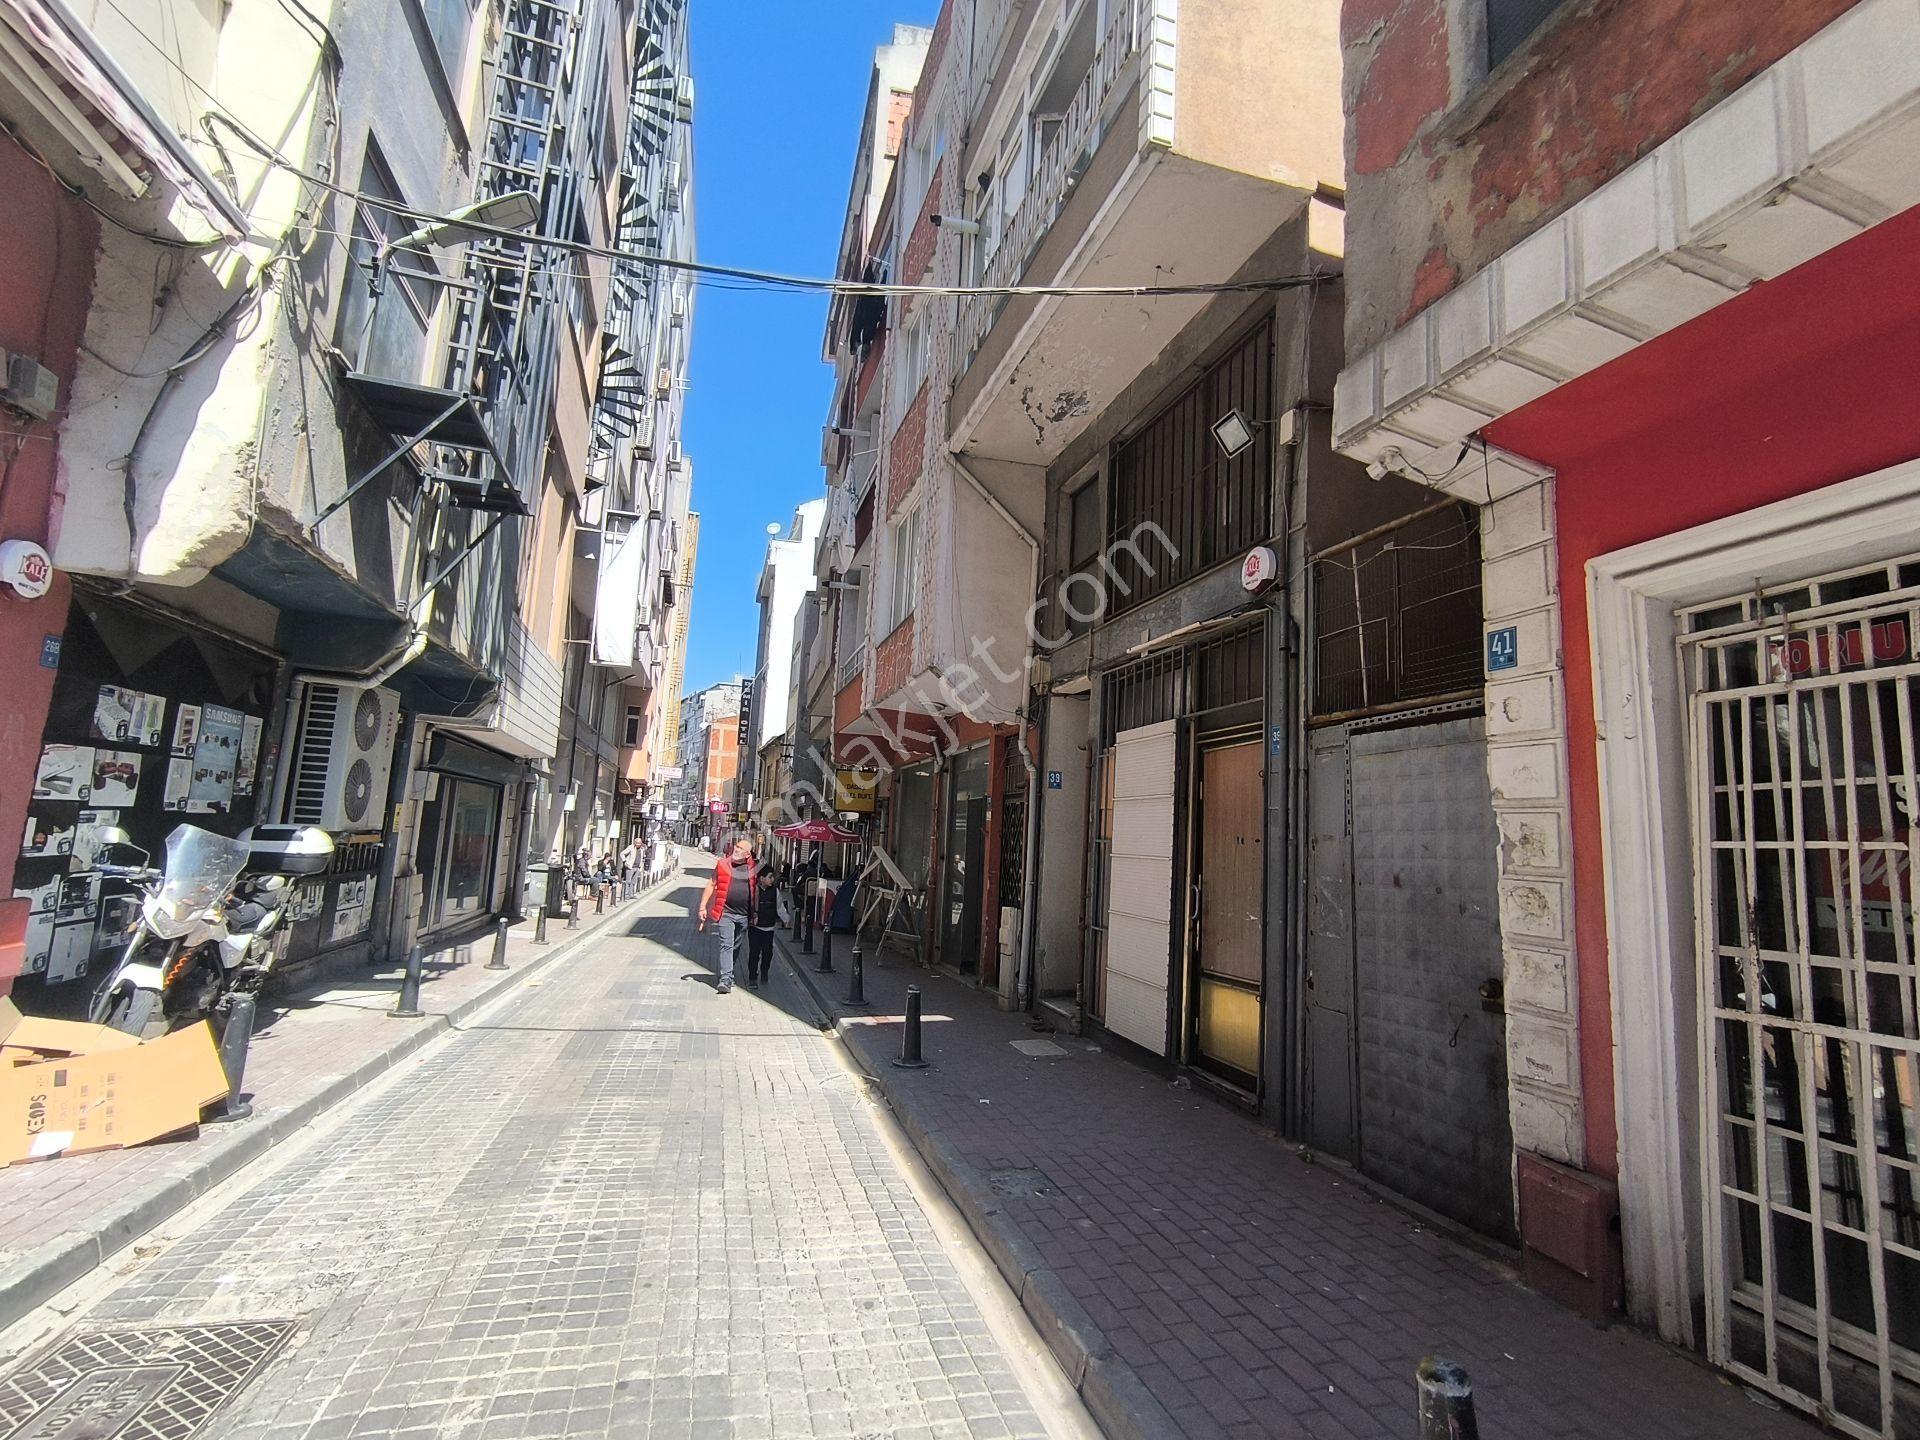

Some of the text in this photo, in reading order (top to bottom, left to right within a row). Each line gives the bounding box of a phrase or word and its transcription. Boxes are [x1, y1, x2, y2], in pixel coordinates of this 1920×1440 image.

[1491, 631, 1513, 655] 41
[205, 708, 242, 725] SAMSUNG
[739, 719, 749, 745] OTEL
[1050, 773, 1061, 783] 39
[27, 1094, 47, 1136] KEOPS
[31, 1377, 119, 1439] TELEKOM
